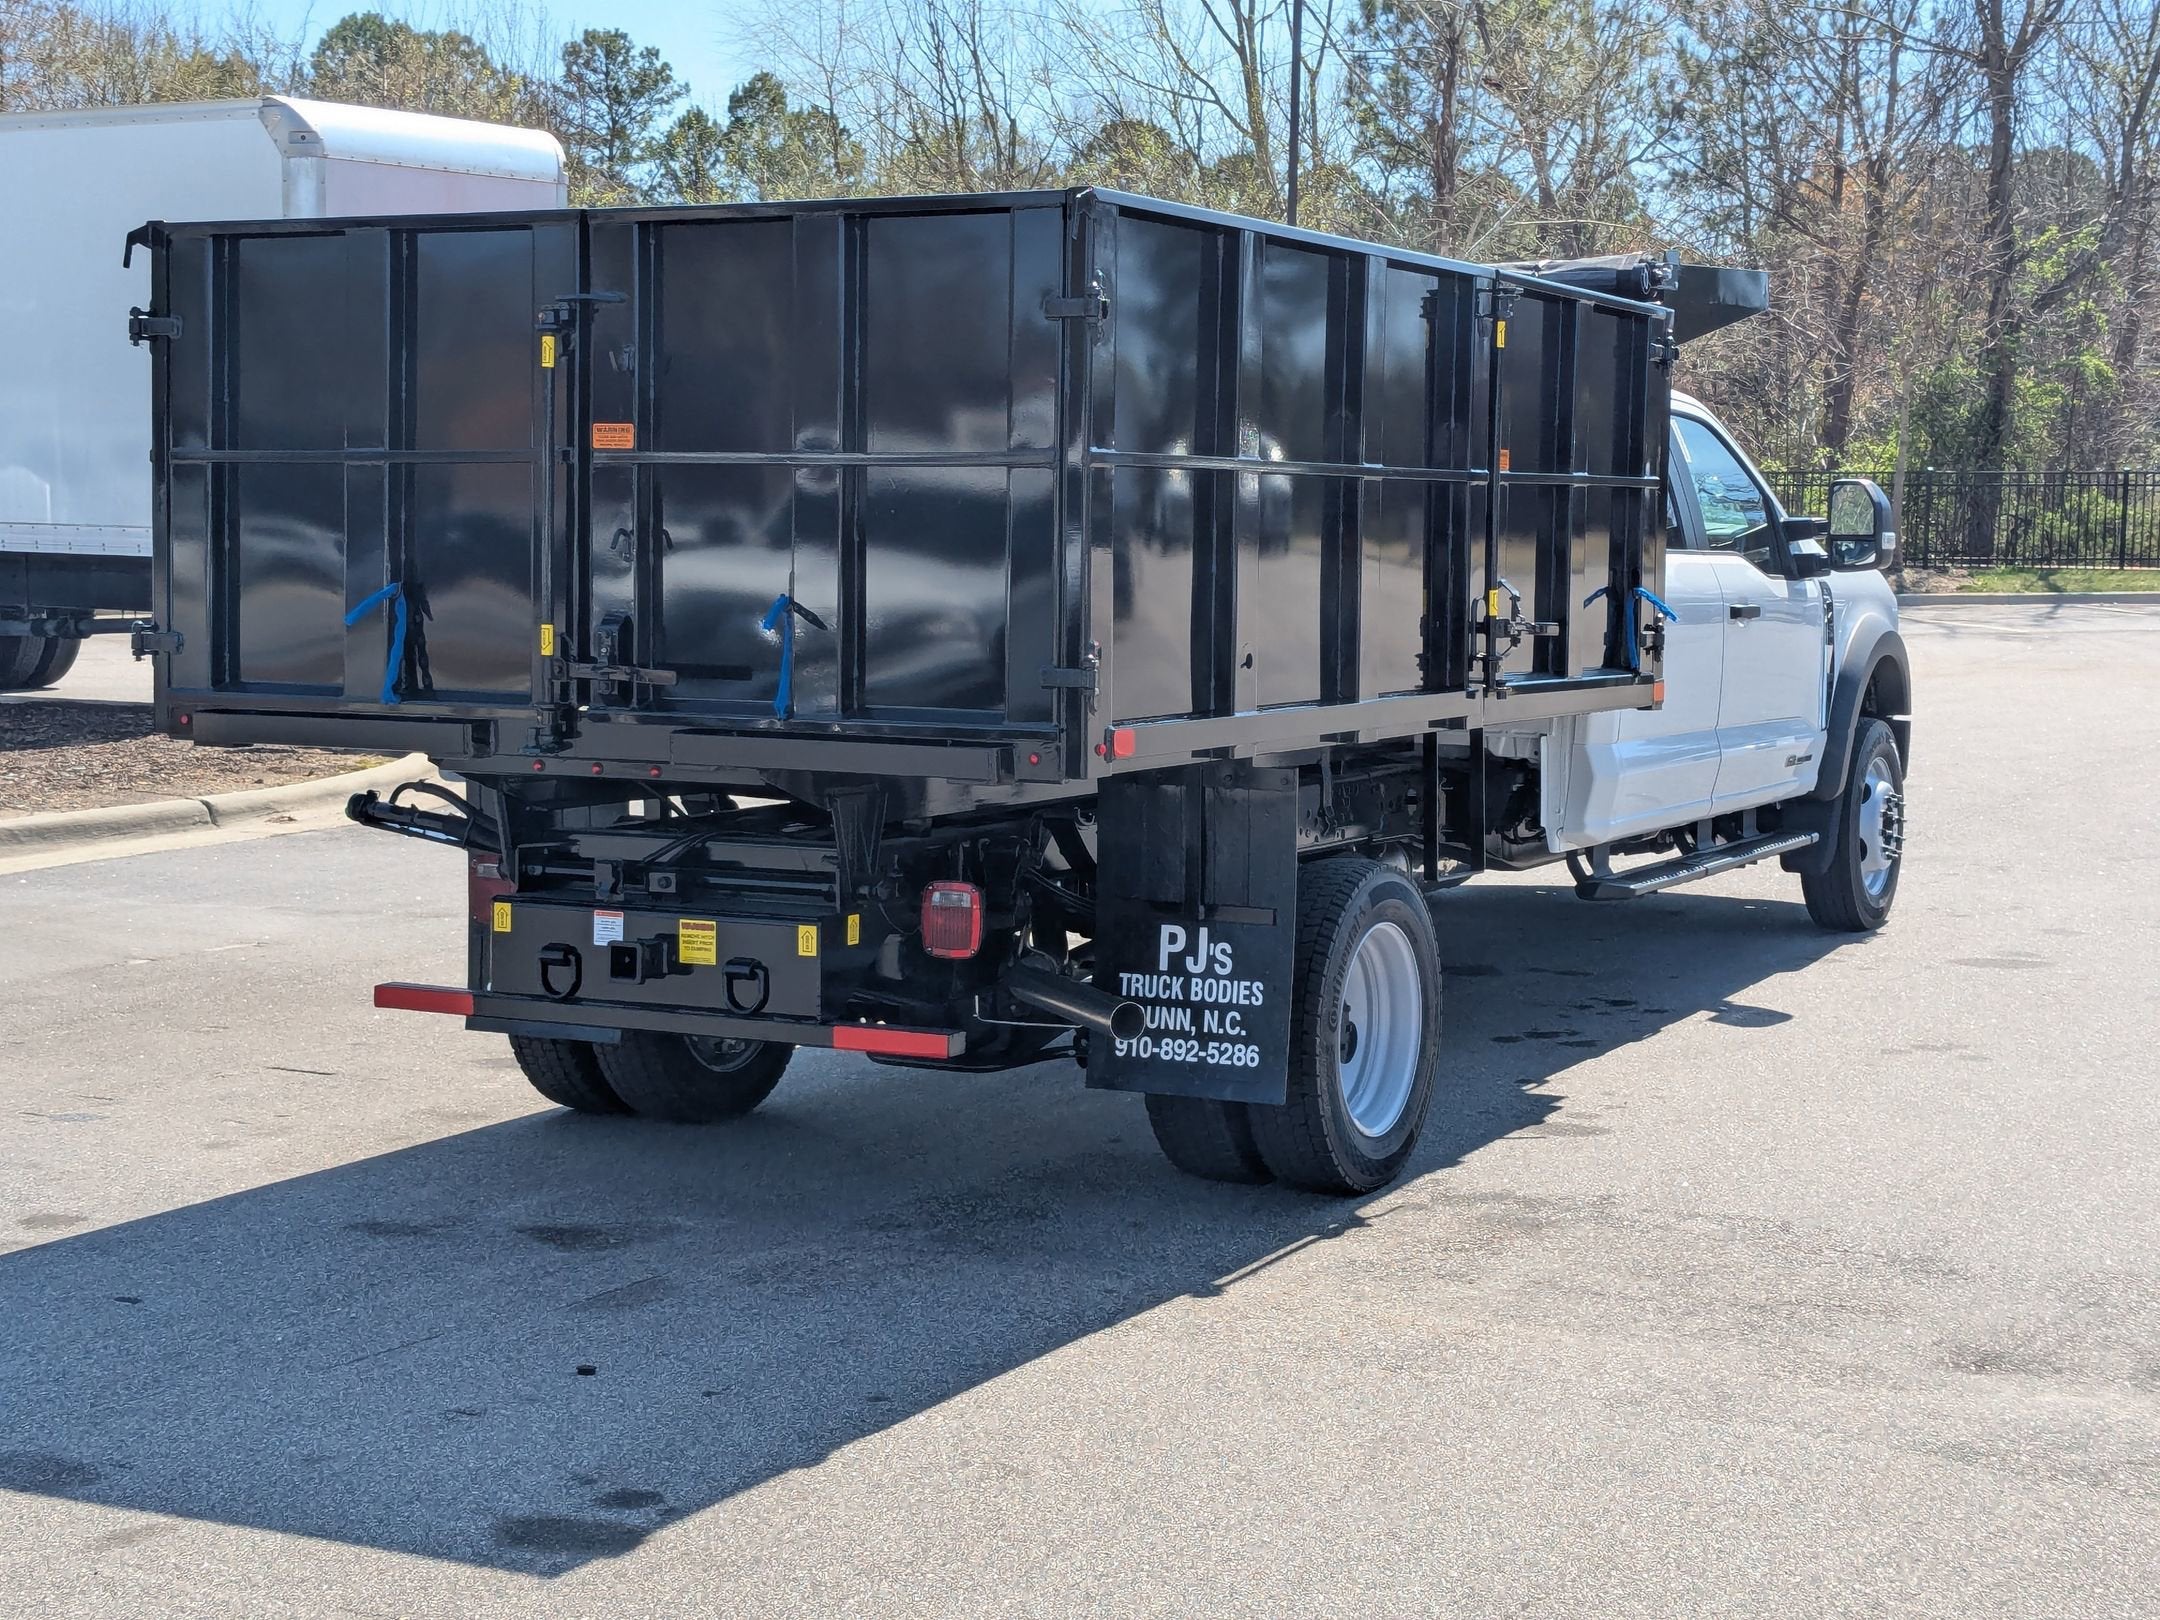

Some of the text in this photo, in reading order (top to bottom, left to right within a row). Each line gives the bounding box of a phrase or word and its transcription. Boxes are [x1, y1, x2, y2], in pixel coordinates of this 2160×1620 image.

[1119, 973, 1264, 1006] TRUCK BODIES
[1144, 1006, 1247, 1036] UNN, N.C.
[1115, 1036, 1260, 1068] 910-892-5286
